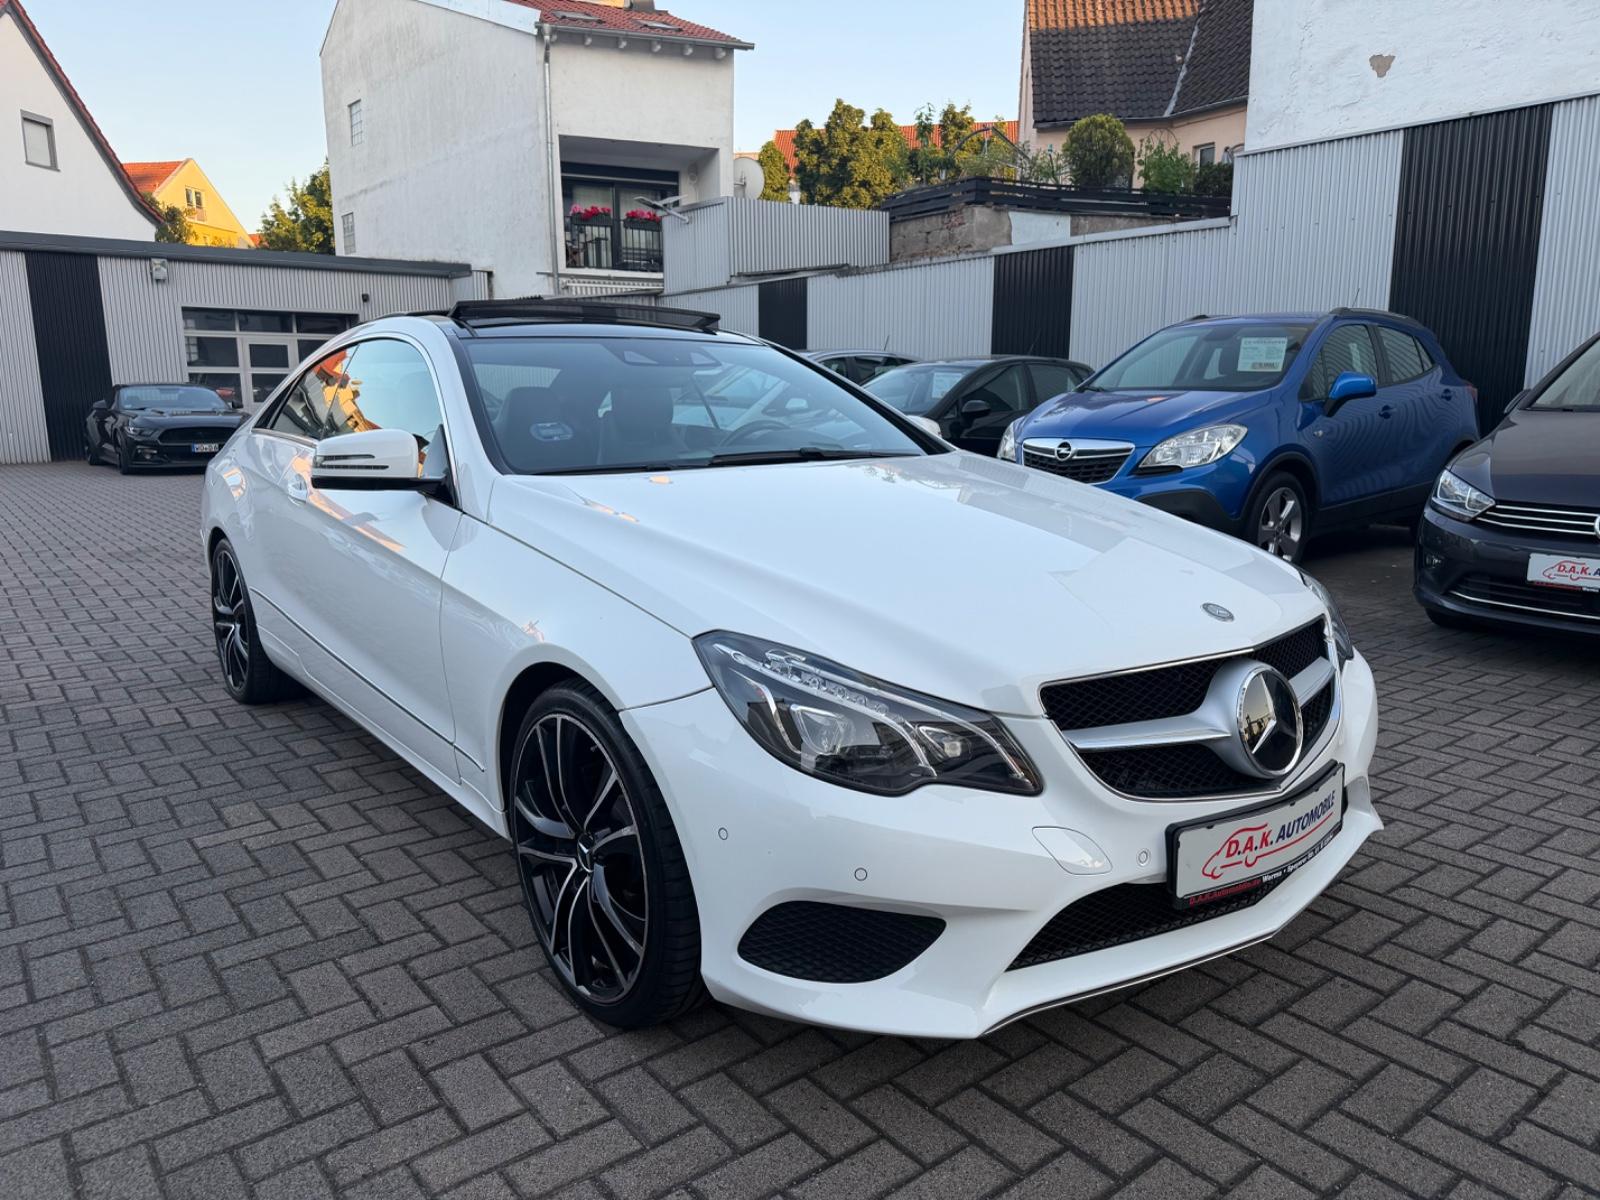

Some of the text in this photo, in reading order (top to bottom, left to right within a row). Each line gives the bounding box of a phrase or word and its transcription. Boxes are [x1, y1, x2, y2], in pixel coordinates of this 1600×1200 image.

[1557, 564, 1592, 576] D.A.K.
[1225, 828, 1274, 858] D.A.K.
[1275, 790, 1336, 844] AUTOMOBILE
